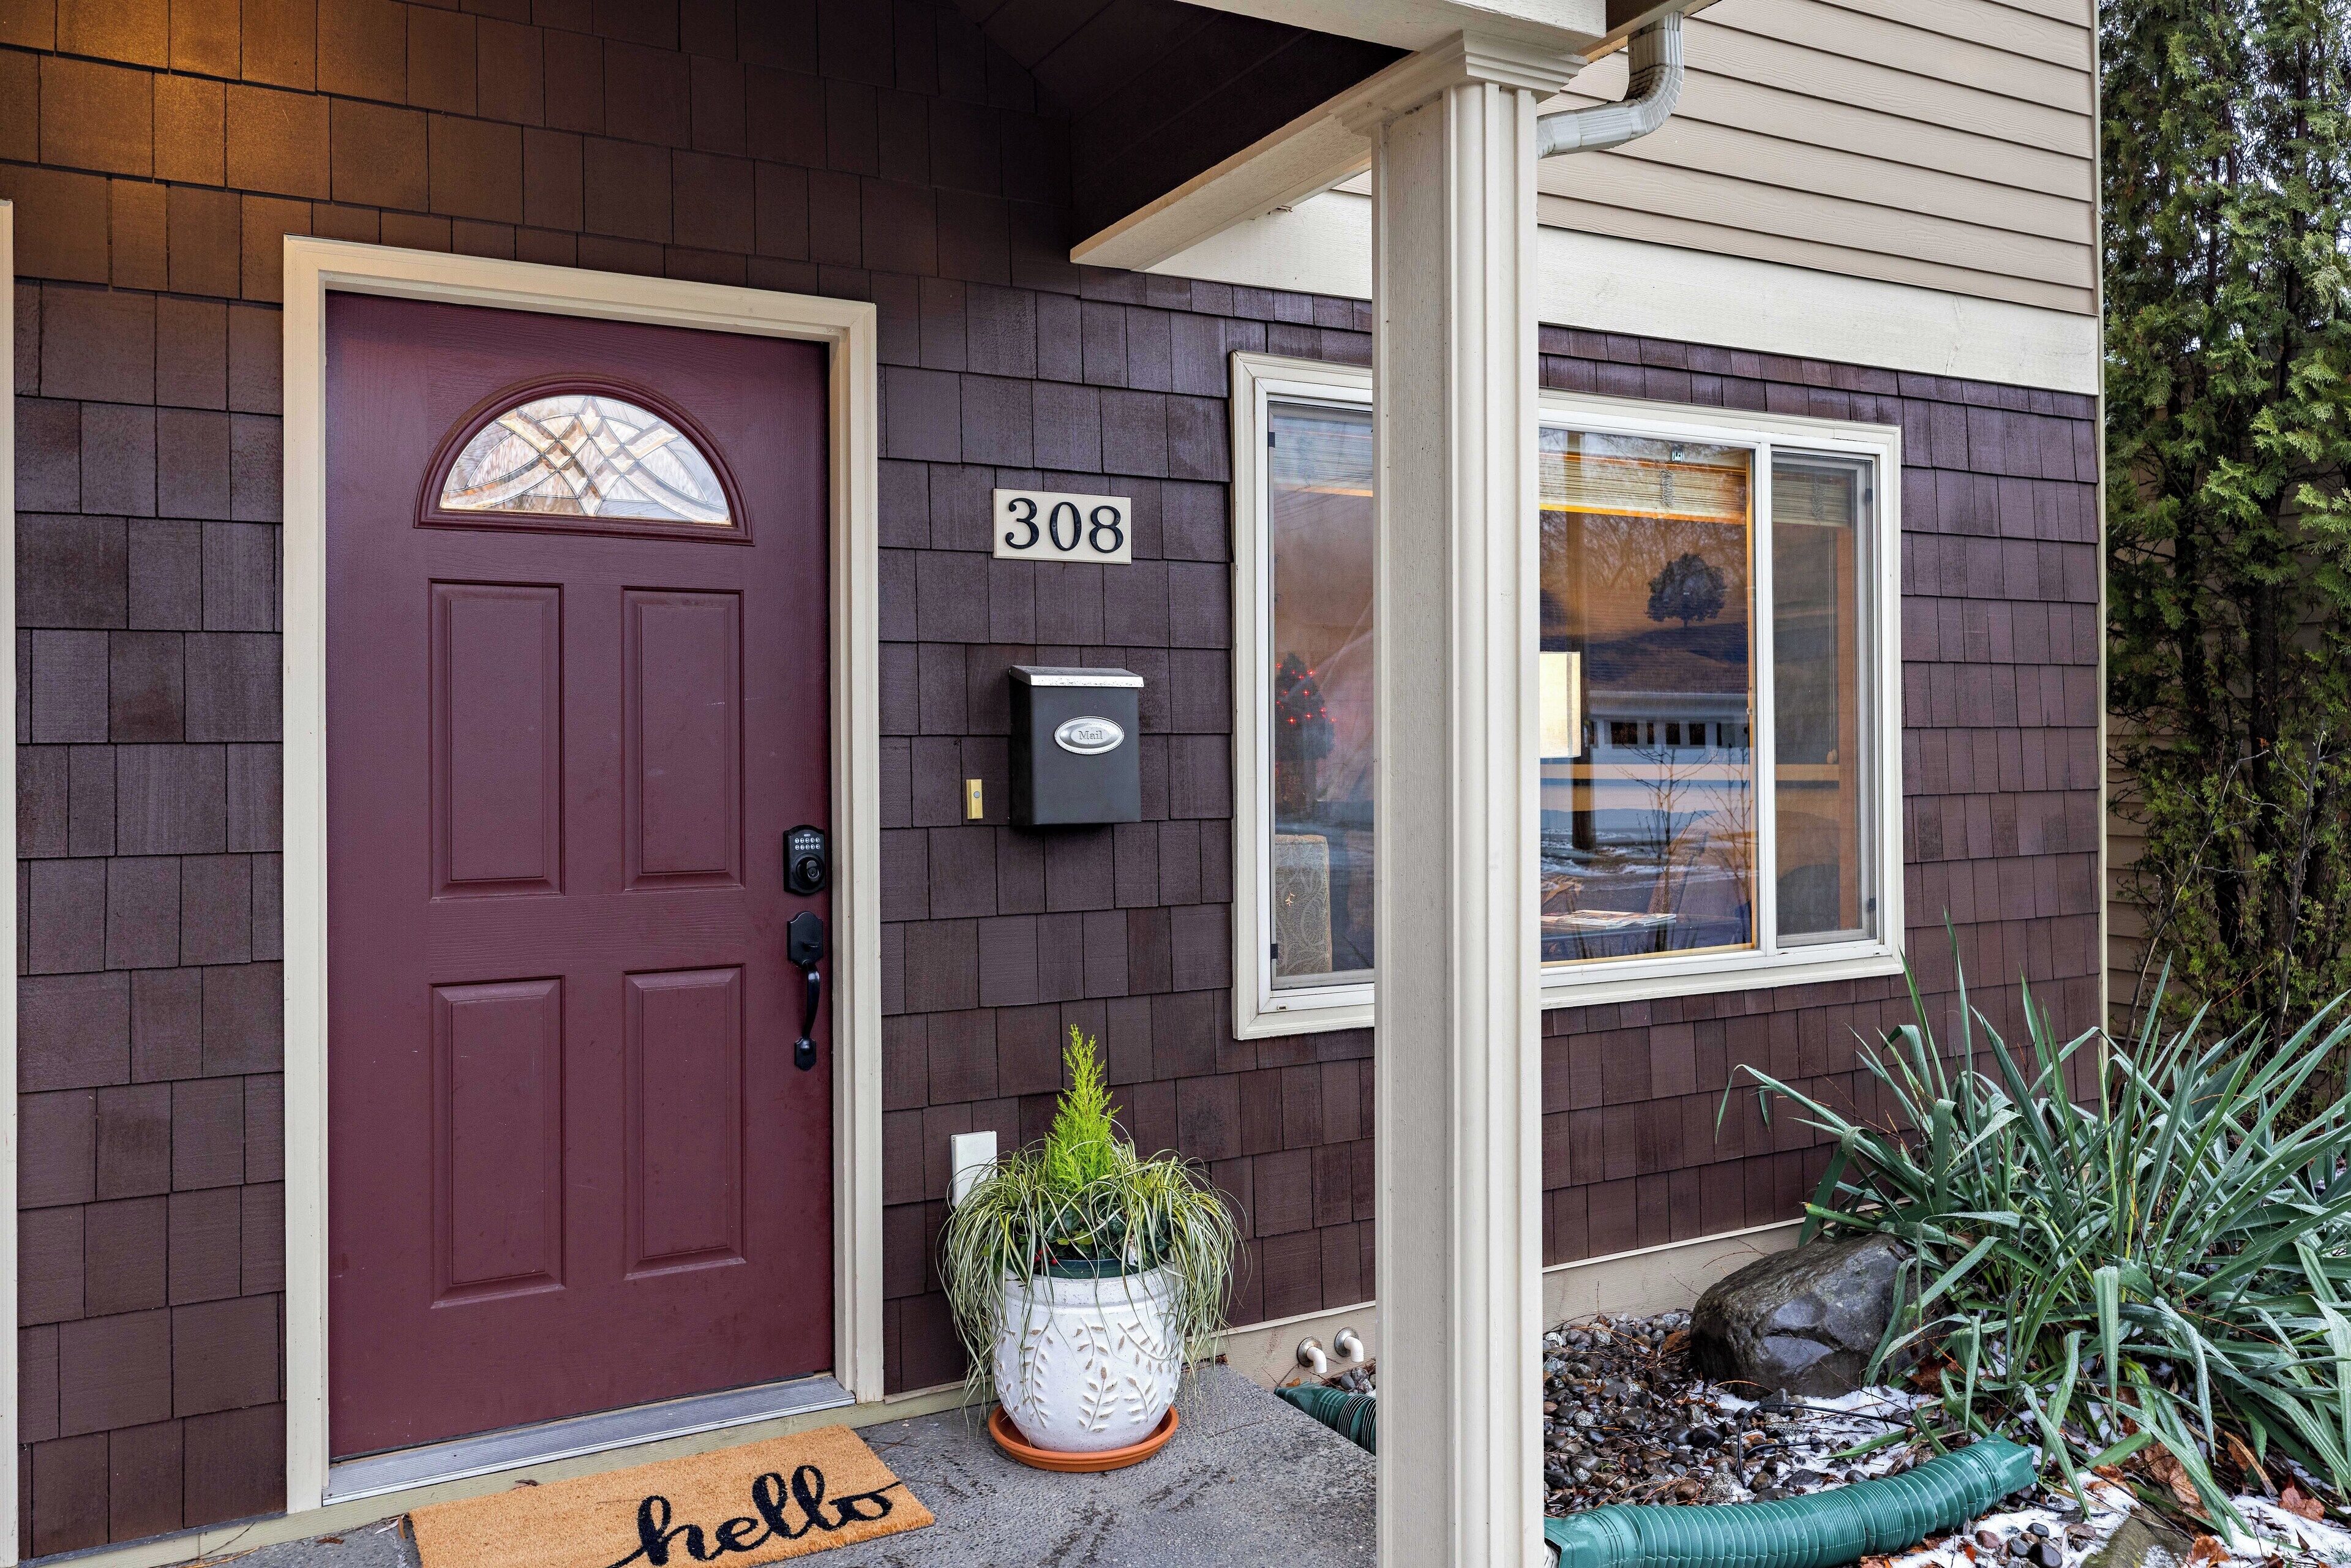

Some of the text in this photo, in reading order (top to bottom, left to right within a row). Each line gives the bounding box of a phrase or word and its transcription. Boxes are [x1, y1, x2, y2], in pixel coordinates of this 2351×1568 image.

[1005, 497, 1124, 553] 308
[1078, 730, 1103, 740] Mail
[605, 1465, 903, 1568] hello
